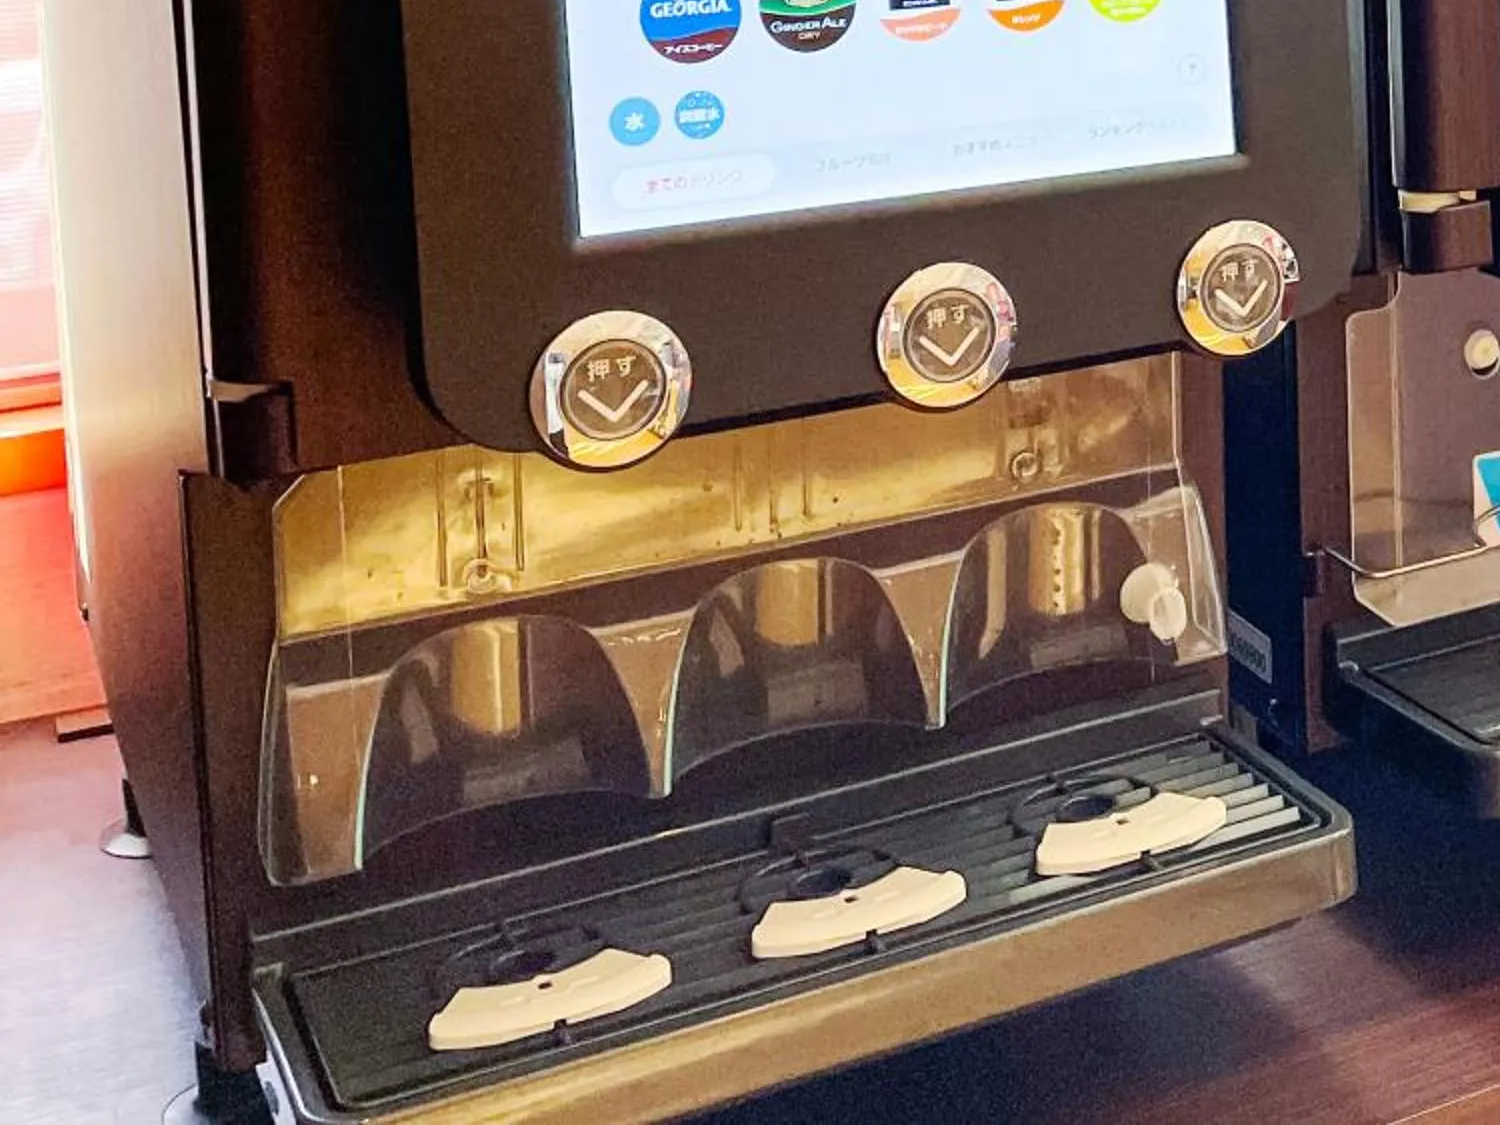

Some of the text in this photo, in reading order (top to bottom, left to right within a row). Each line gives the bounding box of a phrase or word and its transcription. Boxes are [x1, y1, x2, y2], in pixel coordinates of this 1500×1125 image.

[624, 111, 645, 132] 水
[1220, 258, 1259, 283] 押す
[926, 304, 968, 331] 押す
[587, 354, 637, 382] 押す
